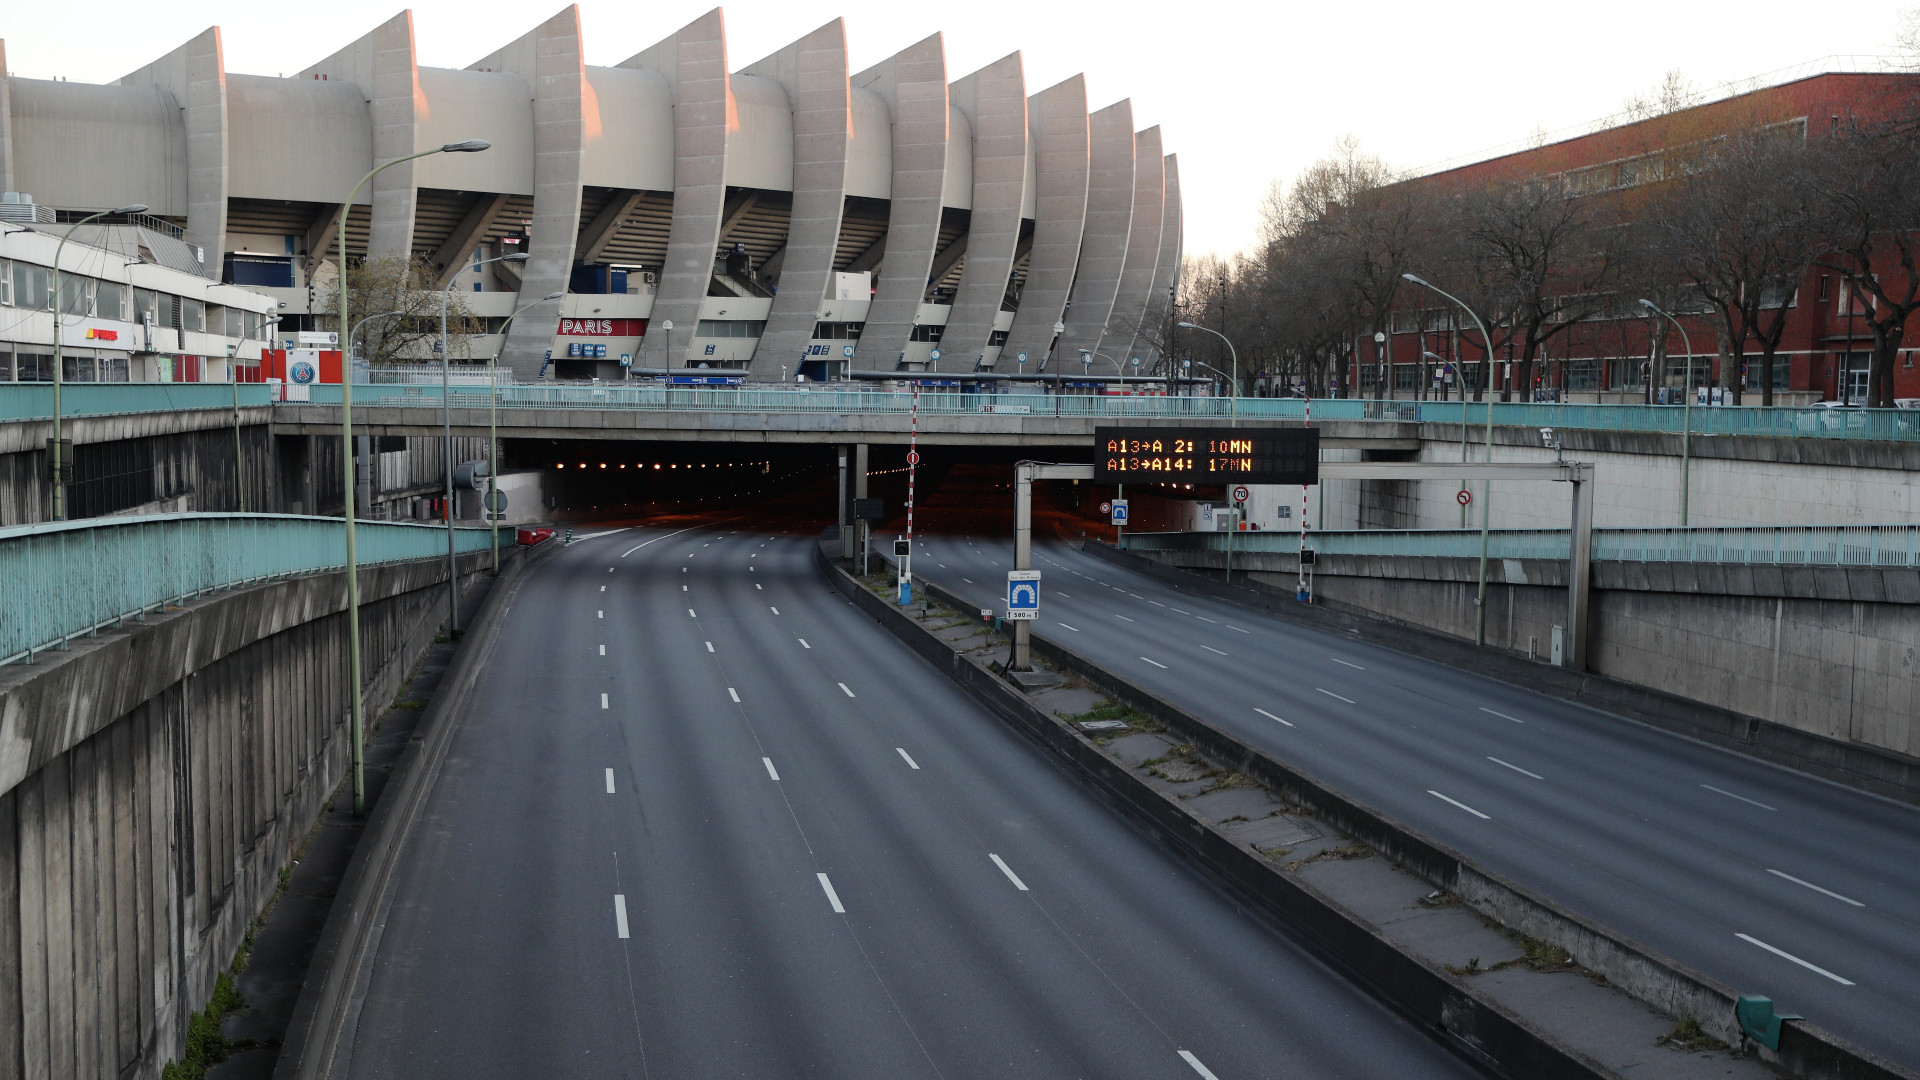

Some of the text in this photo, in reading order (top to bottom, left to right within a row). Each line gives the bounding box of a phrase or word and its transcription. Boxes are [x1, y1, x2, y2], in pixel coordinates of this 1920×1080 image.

[562, 319, 613, 334] PARIS
[1107, 439, 1140, 453] A13
[1152, 439, 1163, 453] A
[1209, 440, 1252, 453] 10MN
[1107, 458, 1251, 471] A13 A14: 17MN
[1236, 490, 1246, 498] 70
